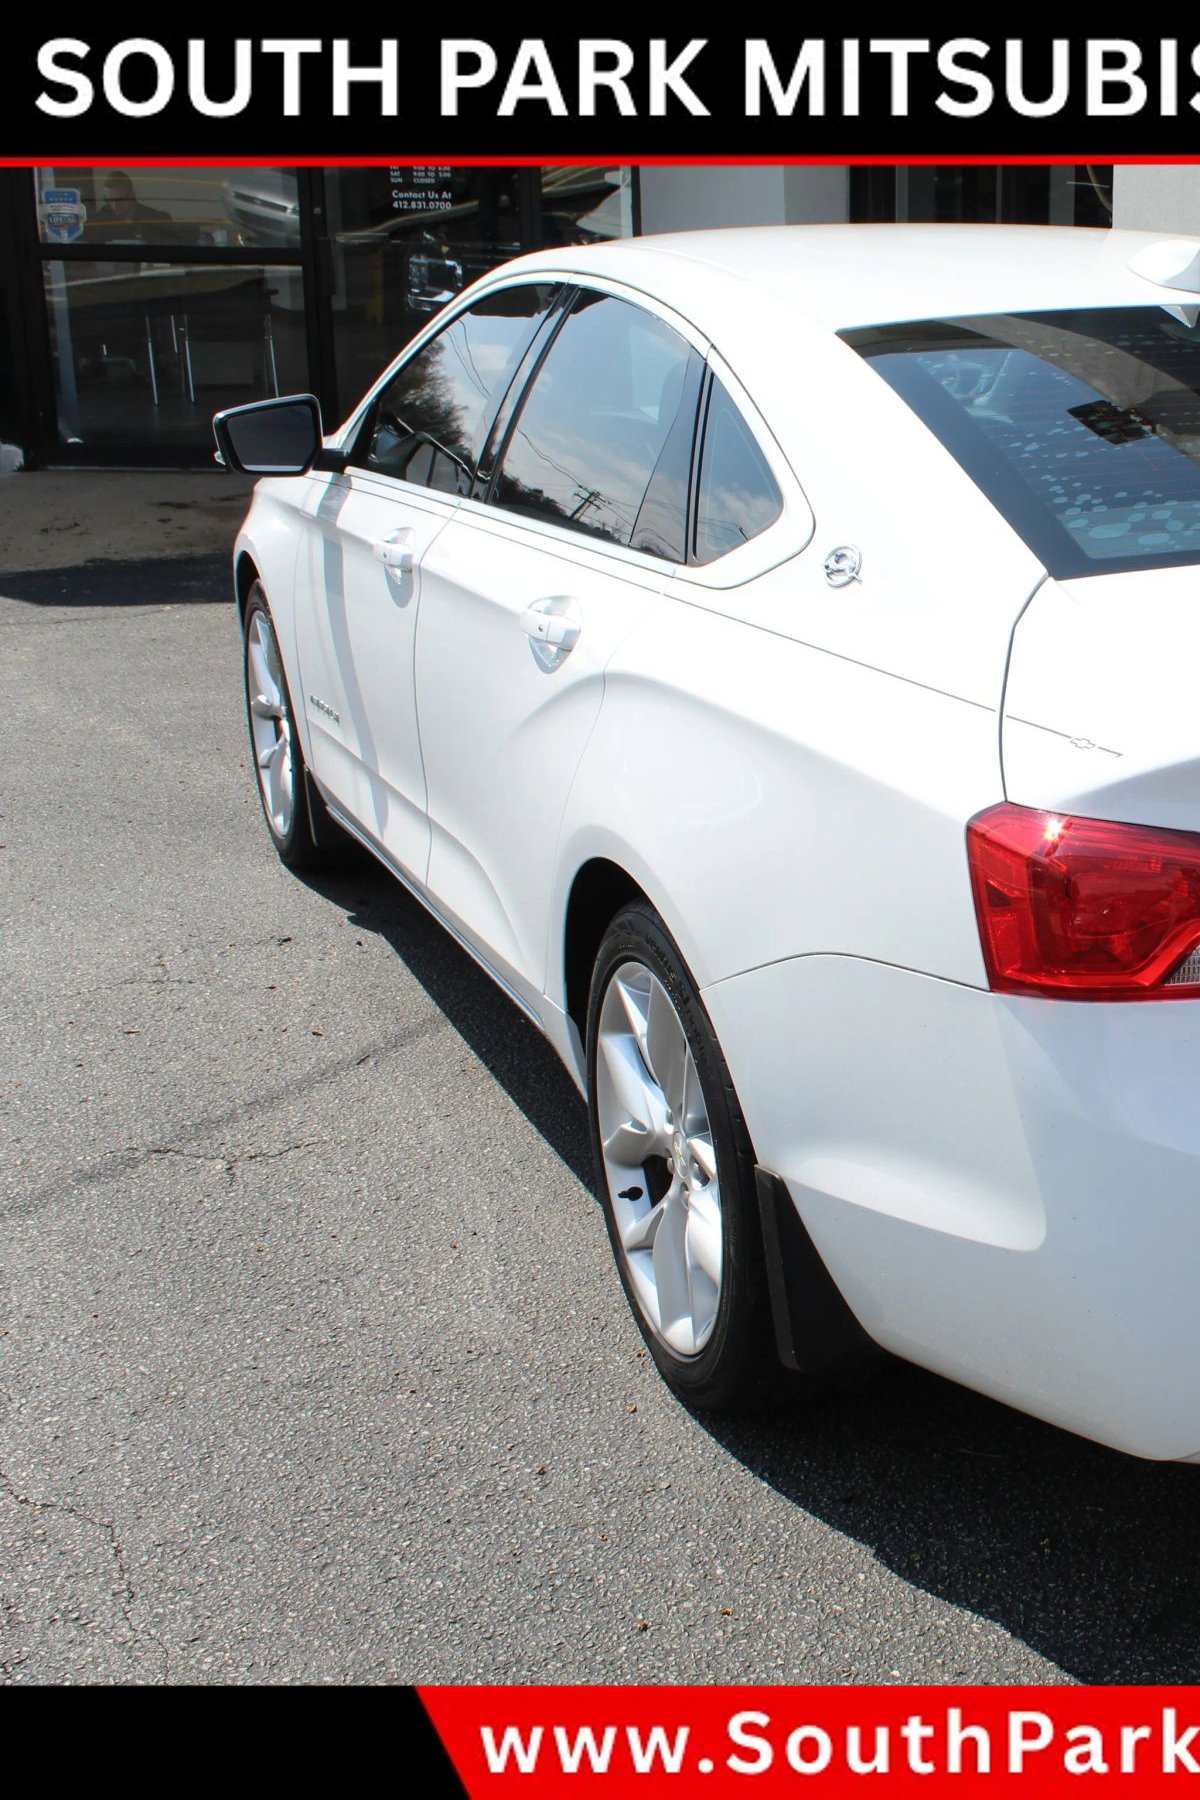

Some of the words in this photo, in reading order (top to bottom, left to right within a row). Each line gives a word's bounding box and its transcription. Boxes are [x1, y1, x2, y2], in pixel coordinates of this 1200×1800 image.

[392, 190, 425, 199] Contact
[427, 191, 439, 199] Us
[441, 191, 452, 199] At
[392, 201, 452, 210] 412.831.0700
